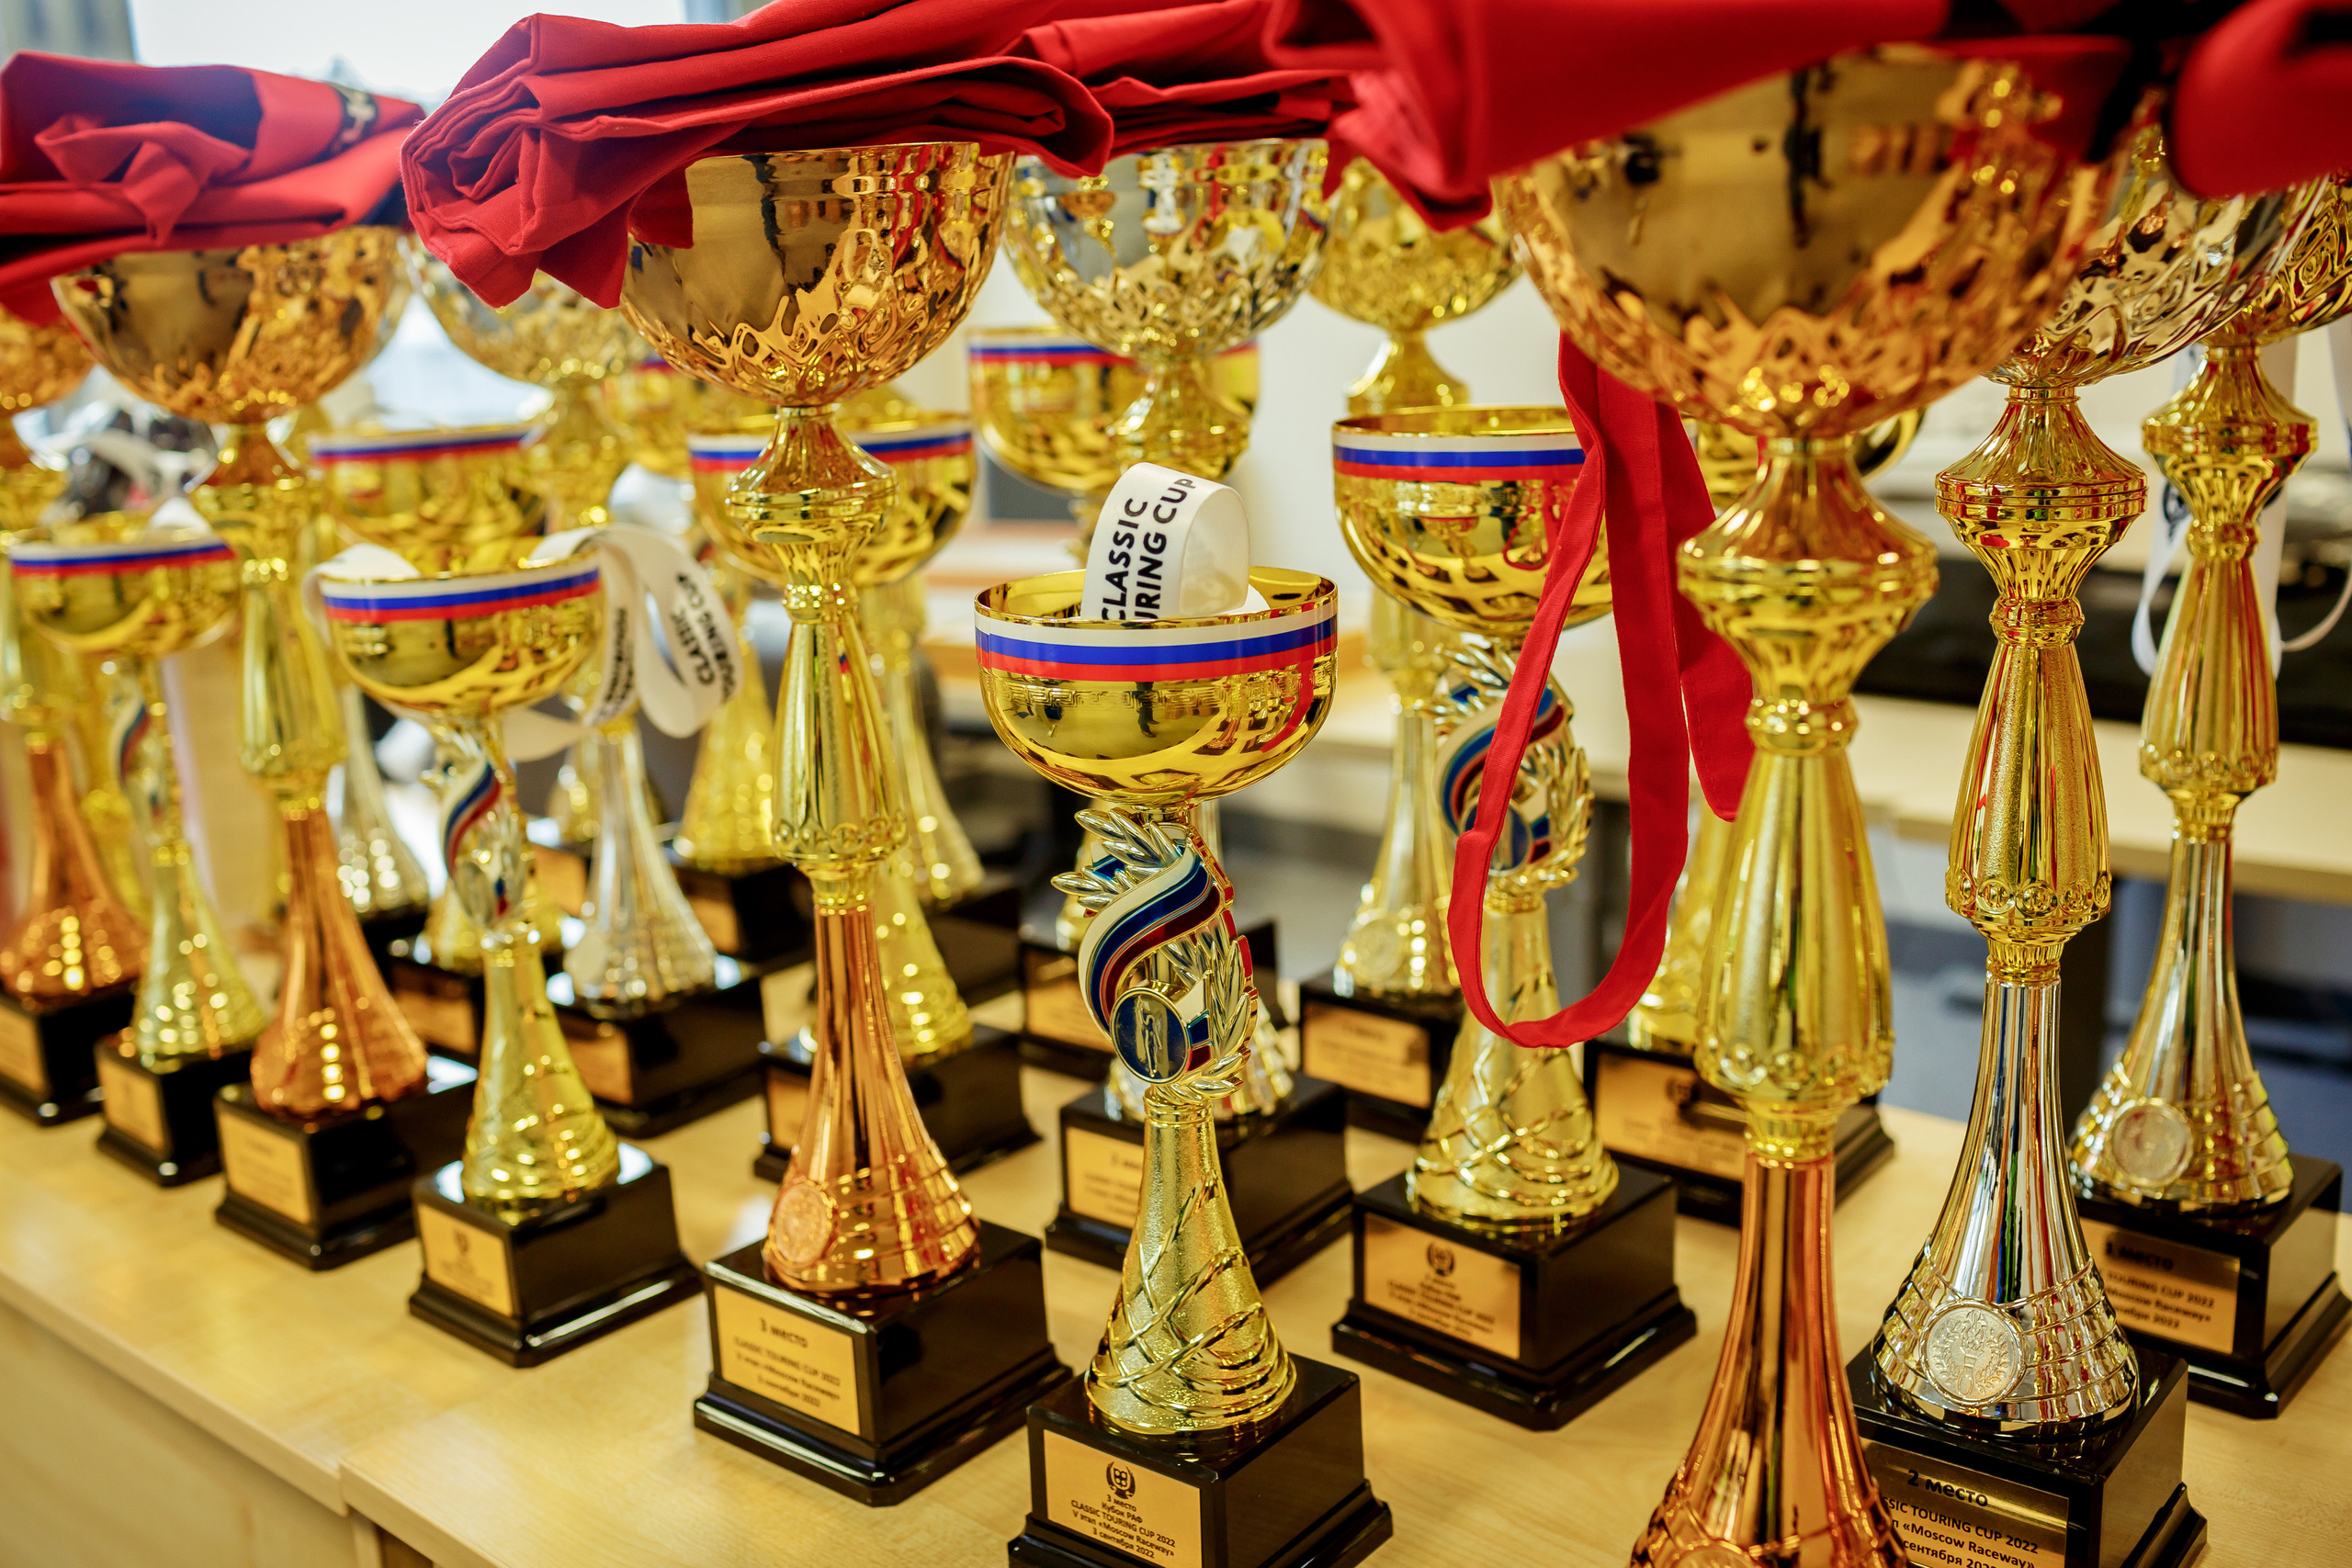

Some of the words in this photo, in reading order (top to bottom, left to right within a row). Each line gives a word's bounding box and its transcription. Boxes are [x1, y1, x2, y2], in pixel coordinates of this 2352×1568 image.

[1102, 498, 1148, 620] CLASSIC
[1135, 532, 1167, 619] RING
[1153, 479, 1196, 524] CUP
[1106, 1494, 1112, 1502] 3
[1114, 1498, 1137, 1512] место
[1907, 1469, 1919, 1487] 2
[1925, 1479, 1988, 1506] место
[1070, 1499, 1101, 1517] CLASSIC
[1102, 1512, 1137, 1531] TOURING
[1139, 1527, 1155, 1538] CUP
[1157, 1533, 1176, 1548] 2022
[1911, 1505, 1972, 1533] TOURING
[1975, 1526, 2002, 1541] CUP
[2006, 1535, 2039, 1554] 2022
[1136, 1545, 1155, 1559] 2022
[1903, 1540, 1962, 1566] сентября
